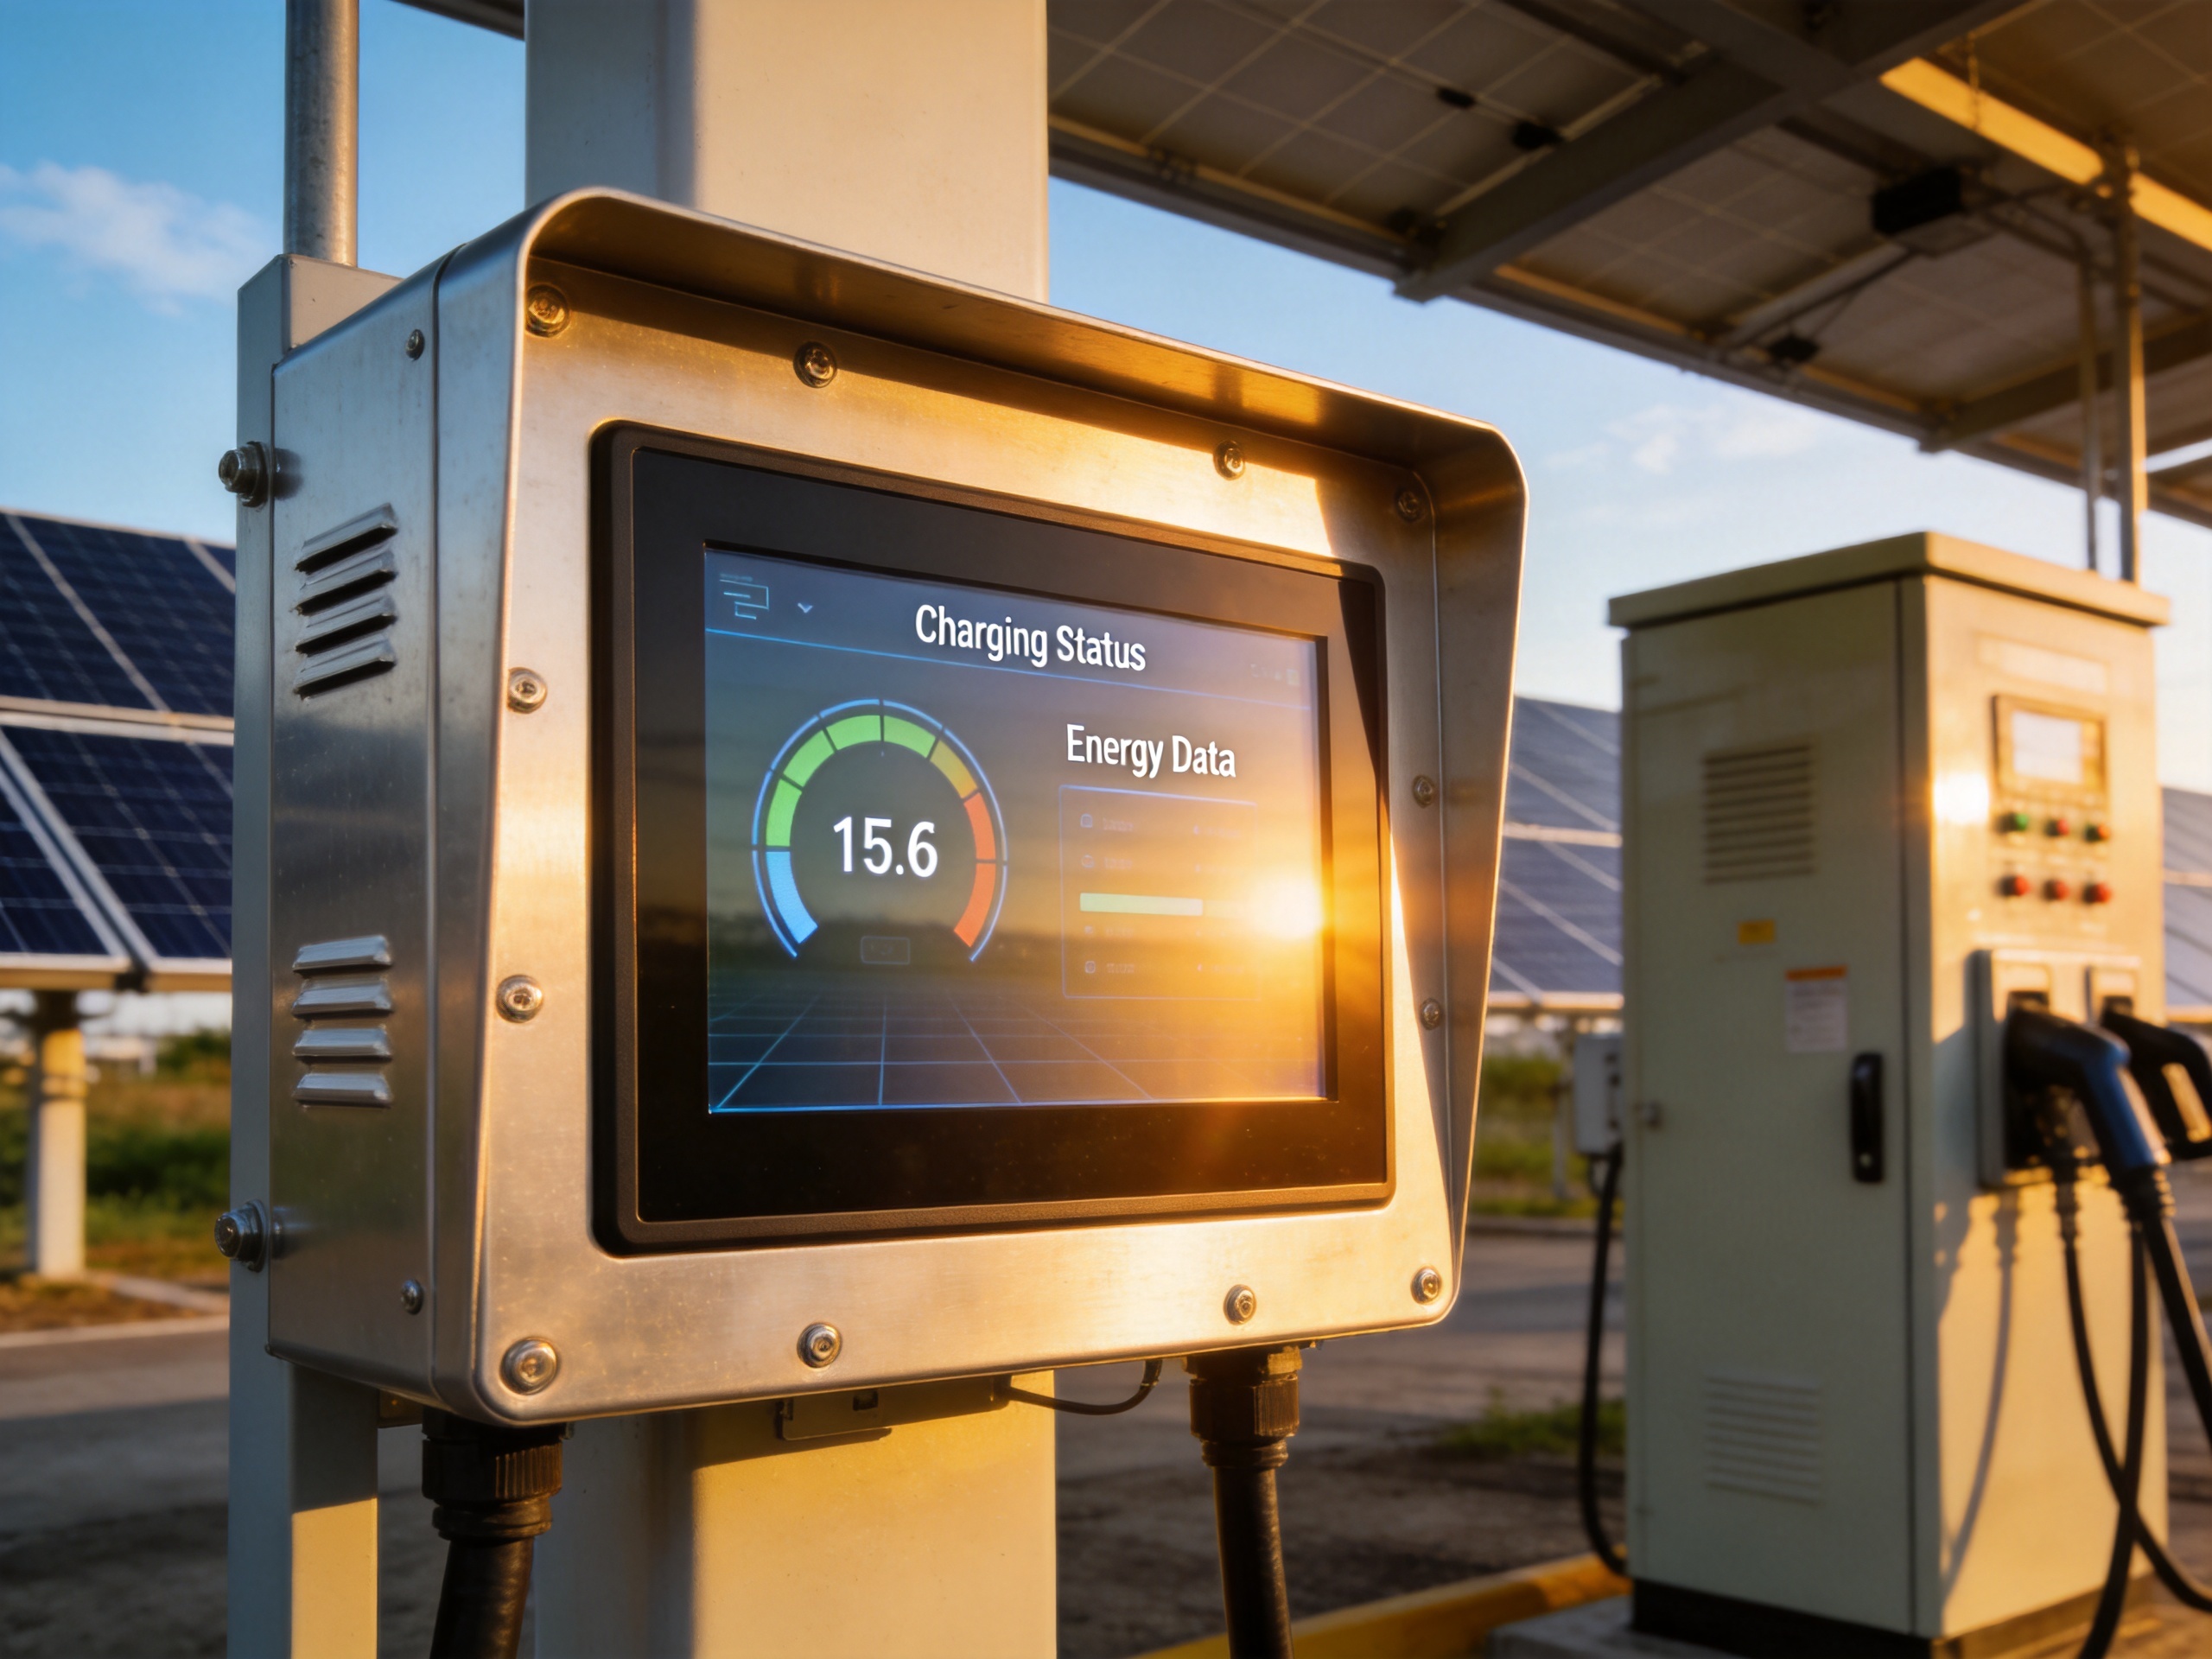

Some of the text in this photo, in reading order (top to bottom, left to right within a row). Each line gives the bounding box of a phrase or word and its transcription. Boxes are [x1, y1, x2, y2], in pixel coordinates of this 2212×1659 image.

[916, 605, 1146, 671] Charging Status
[1066, 723, 1236, 778] Energy Data
[833, 817, 938, 878] 15.6
